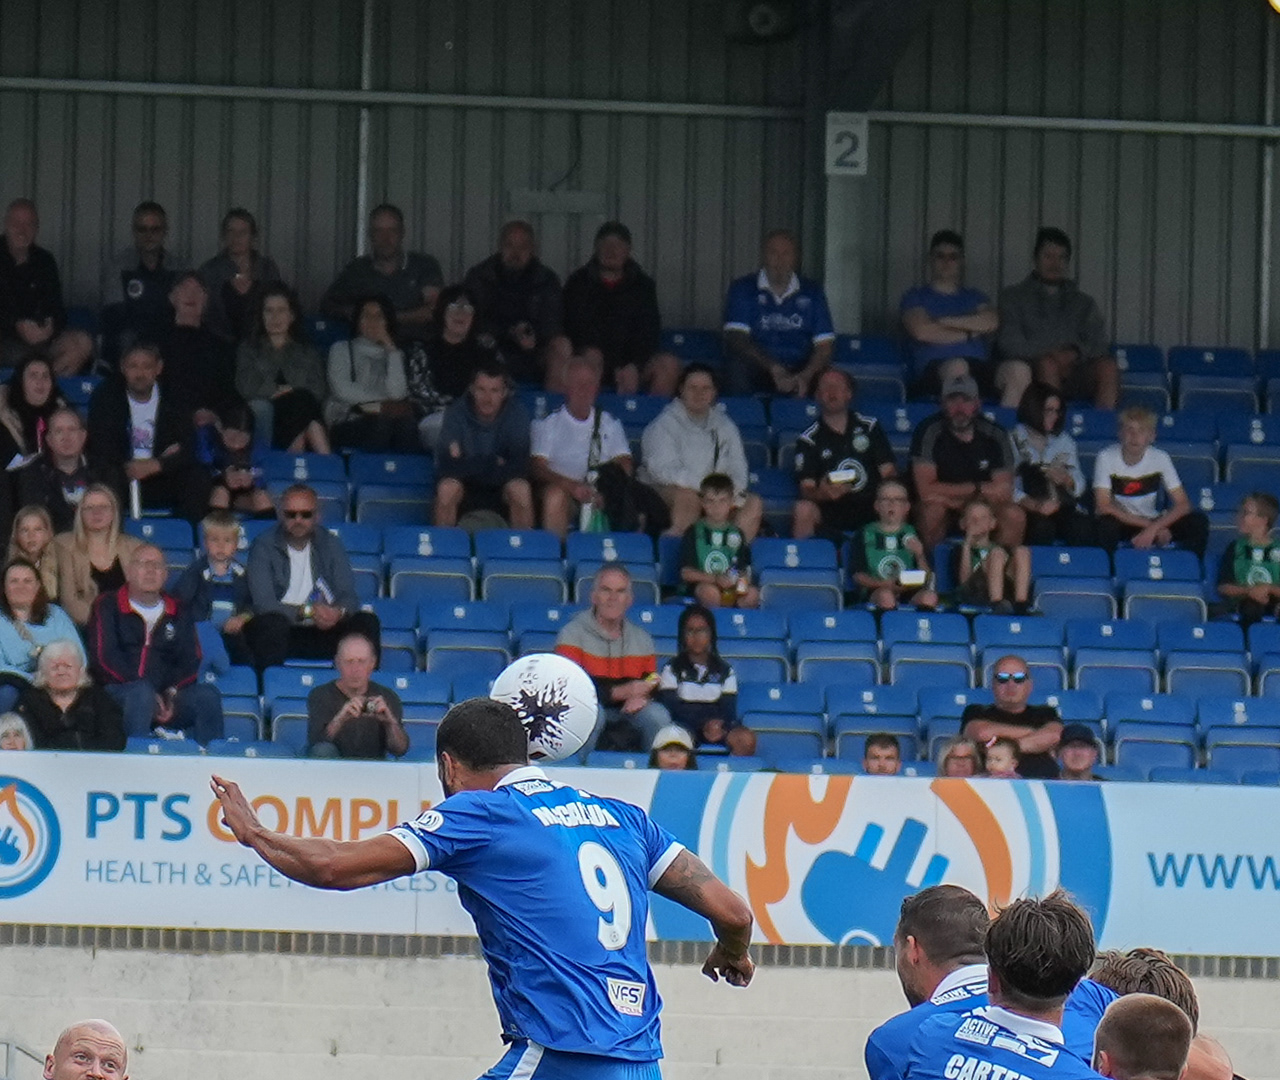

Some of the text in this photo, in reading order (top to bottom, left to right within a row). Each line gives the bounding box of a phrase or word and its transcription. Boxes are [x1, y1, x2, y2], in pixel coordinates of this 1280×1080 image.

[833, 130, 860, 168] 2
[86, 792, 192, 842] PTS
[85, 860, 186, 886] HEALTH
[194, 863, 213, 887] &
[578, 841, 631, 950] 9
[610, 983, 642, 1004] VFS
